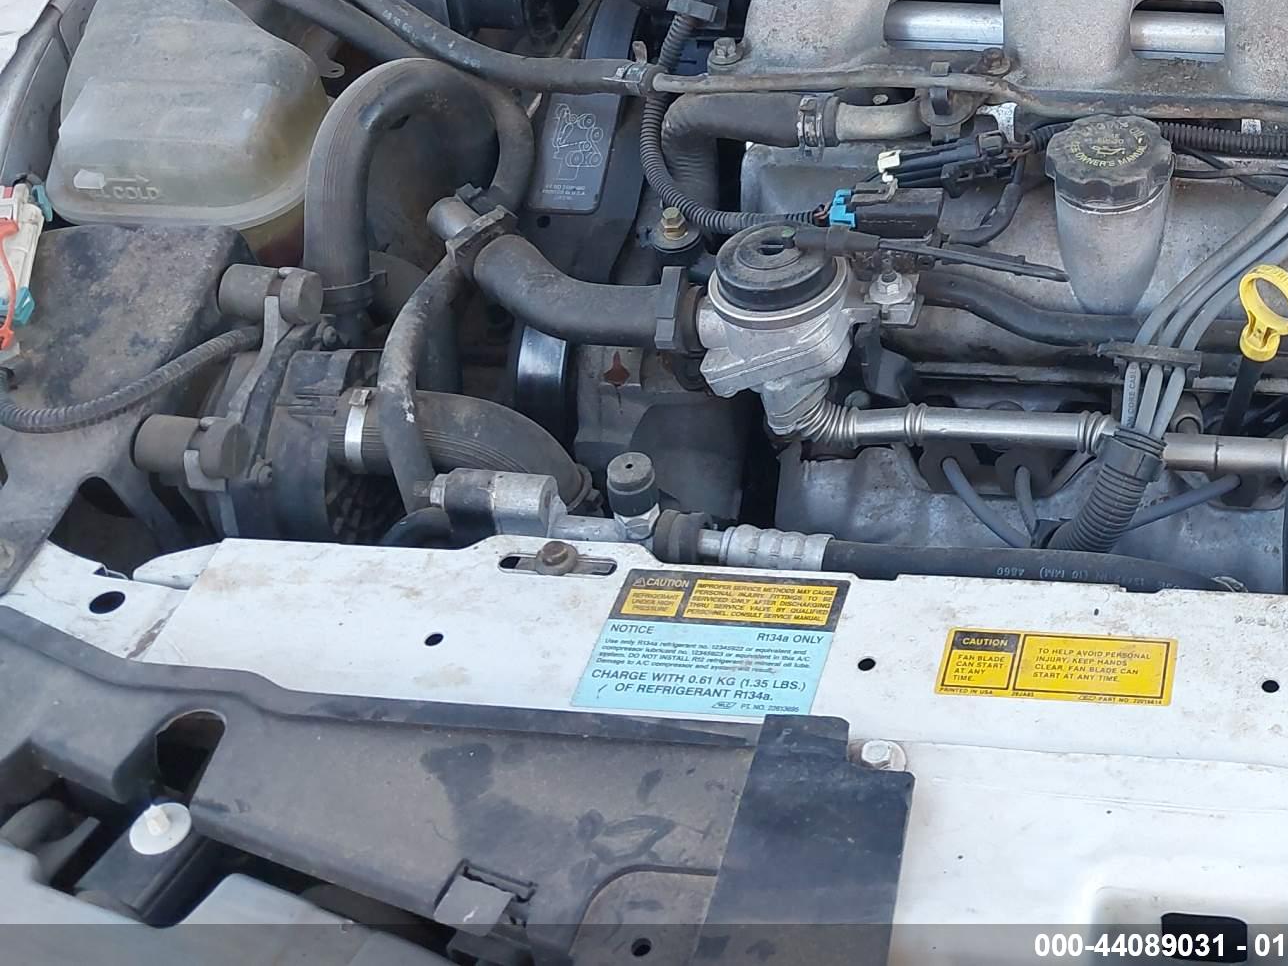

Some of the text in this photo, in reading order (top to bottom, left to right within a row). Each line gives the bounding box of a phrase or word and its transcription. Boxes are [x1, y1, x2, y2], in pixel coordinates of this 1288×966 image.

[646, 578, 690, 588] CAUTION
[733, 584, 761, 592] SERVICE
[763, 586, 795, 594] METHODS
[610, 624, 654, 634] NOTICE
[756, 633, 824, 644] R134a ONLY
[962, 638, 1008, 646] CAUTION
[660, 654, 689, 662] INSTALL
[1105, 652, 1151, 660] PERSONAL
[592, 669, 806, 691] CHARGE WITH 0.61 KG (1.35 LBS.)
[615, 683, 773, 700] OF REFRIGERANT R134a.
